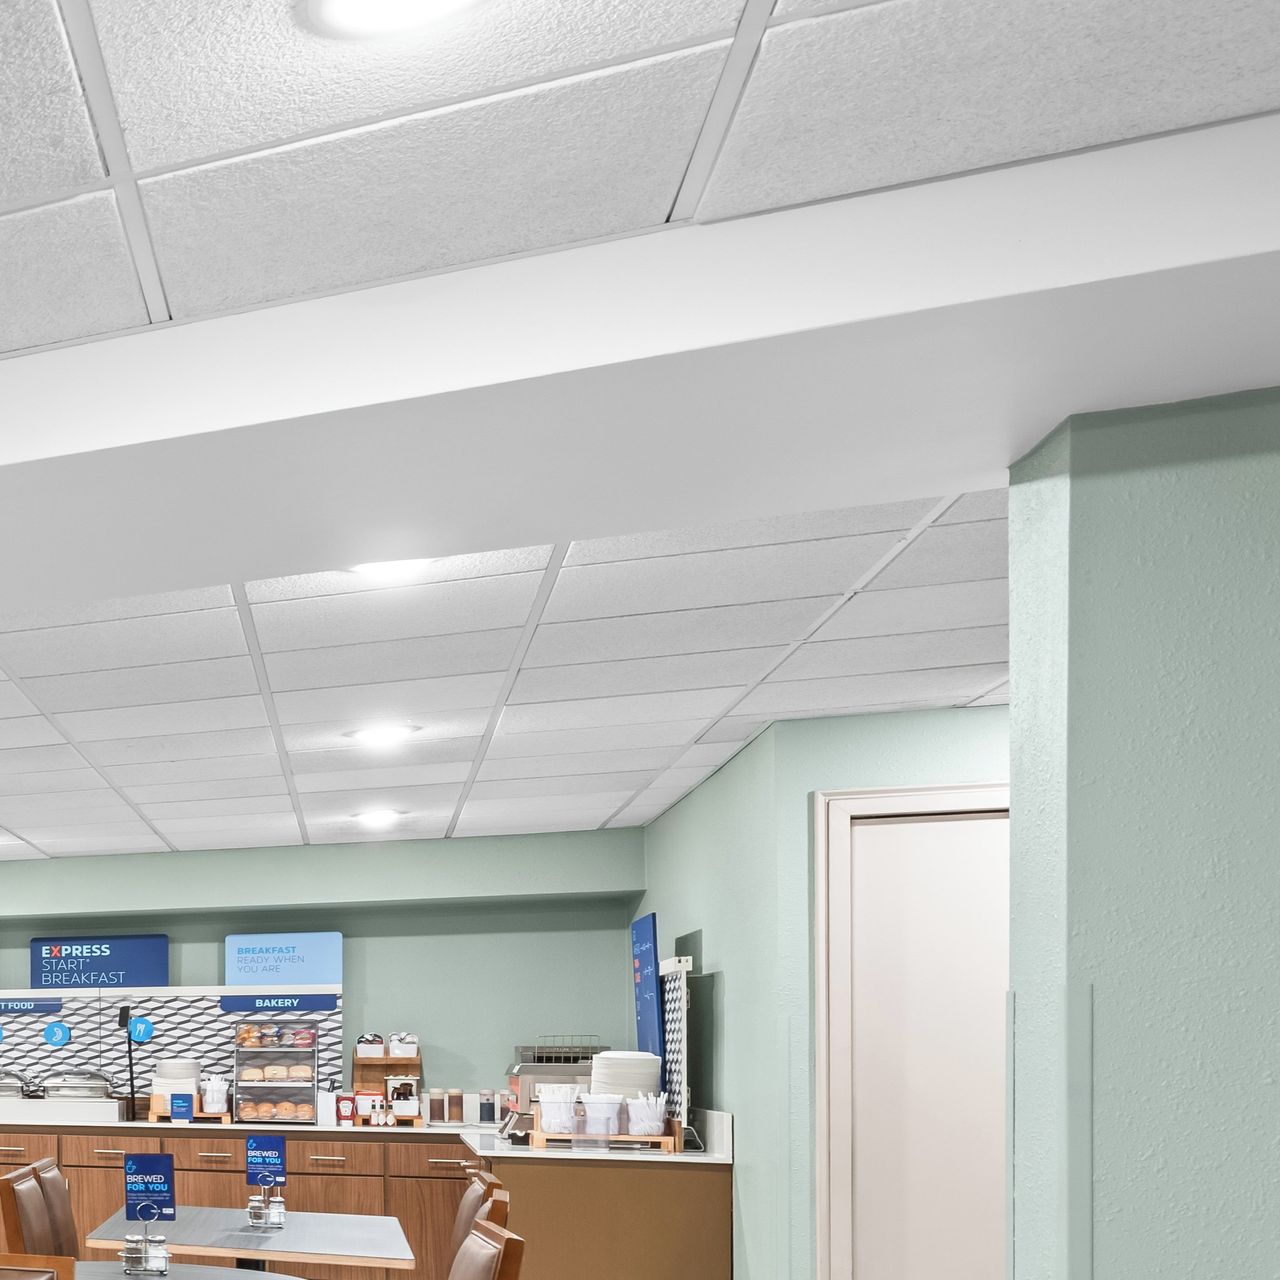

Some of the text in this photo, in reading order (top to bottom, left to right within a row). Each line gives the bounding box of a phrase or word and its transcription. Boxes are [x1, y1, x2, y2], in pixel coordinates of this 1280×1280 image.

[42, 945, 111, 957] EXPRESS
[237, 946, 297, 955] BREAKFAST
[237, 955, 305, 964] READY WHEN
[237, 964, 281, 974] YOU ARE
[42, 972, 126, 985] BREAKFAST
[8, 1001, 34, 1010] FOOD
[255, 998, 300, 1008] BAKERY
[247, 1150, 279, 1158] BREWED
[126, 1174, 165, 1183] BREWED
[127, 1183, 168, 1191] FOR YOU
